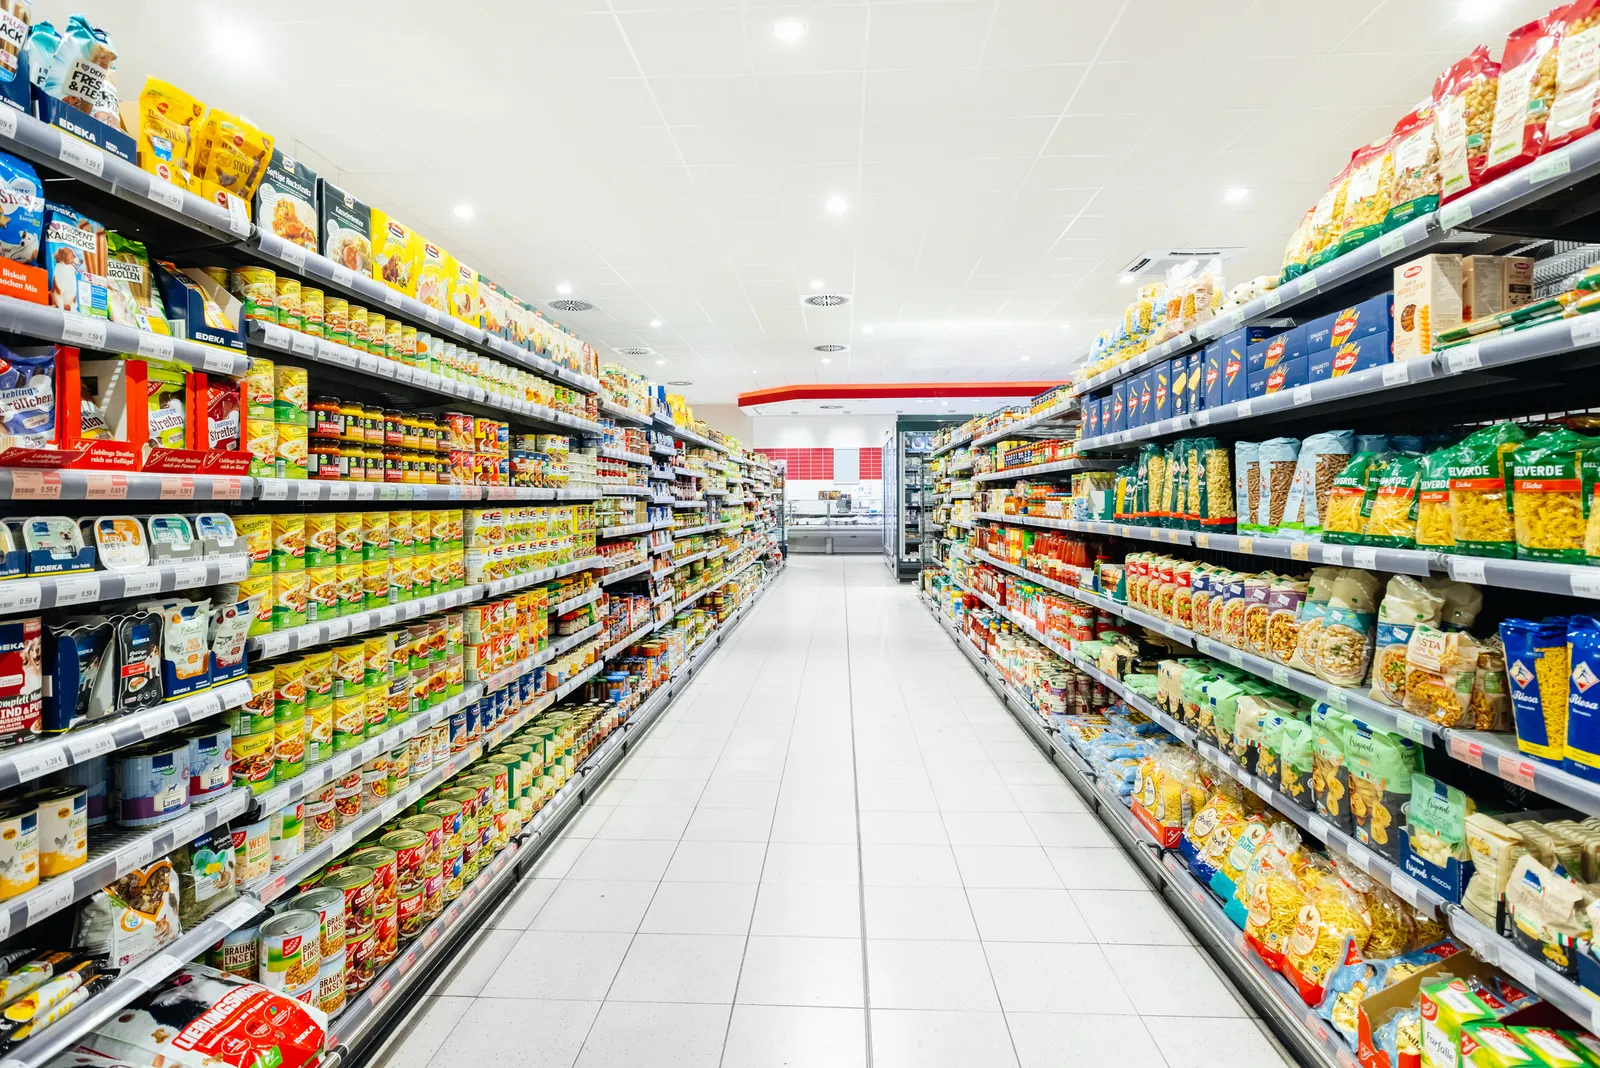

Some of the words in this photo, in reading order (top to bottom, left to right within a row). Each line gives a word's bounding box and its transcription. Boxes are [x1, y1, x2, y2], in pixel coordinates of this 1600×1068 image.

[3, 14, 25, 33] PLUS
[69, 81, 79, 92] &
[59, 117, 96, 143] EDEKA
[164, 128, 185, 143] STICKS
[85, 158, 96, 168] 1.09
[233, 160, 251, 175] STICKS
[45, 204, 77, 220] EDEKA
[61, 225, 94, 241] PRODENT
[47, 230, 95, 250] KAUSTICKS
[2, 268, 27, 281] Biskuit
[25, 284, 38, 293] Mix
[1334, 319, 1356, 334] Barilla
[88, 331, 99, 341] 1.59
[195, 332, 225, 344] EDEKA
[1267, 345, 1283, 357] Barilla
[1335, 357, 1357, 368] Barilla
[1268, 376, 1283, 387] Barilla
[149, 415, 184, 432] Streifen
[91, 448, 115, 457] Lieblings
[115, 449, 135, 458] Streifen
[1450, 465, 1491, 477] ELVERDE
[41, 485, 53, 493] 0.59
[54, 485, 58, 493] €
[1522, 481, 1543, 490] Eliche
[249, 550, 270, 561] Erasco
[34, 564, 63, 573] EDEKA
[20, 597, 32, 605] 0.59
[132, 637, 150, 646] EDEKA
[213, 673, 229, 682] EDEKA
[173, 686, 191, 695] EDEKA
[1512, 690, 1539, 704] Riesa
[1569, 694, 1599, 710] Riesa
[23, 705, 29, 714] &
[95, 741, 106, 750] 0.99
[198, 745, 218, 754] EDEKA
[44, 757, 57, 767] 1.39
[152, 765, 174, 774] EDEKA
[250, 767, 271, 780] Erasco
[210, 776, 224, 786] Rind
[162, 797, 181, 808] Lamm
[400, 896, 420, 910] FEUER
[225, 941, 256, 956] BRAUNE
[225, 950, 256, 966] LINSEN
[319, 969, 343, 988] BRAUNE
[1426, 1031, 1454, 1061] Farfalle
